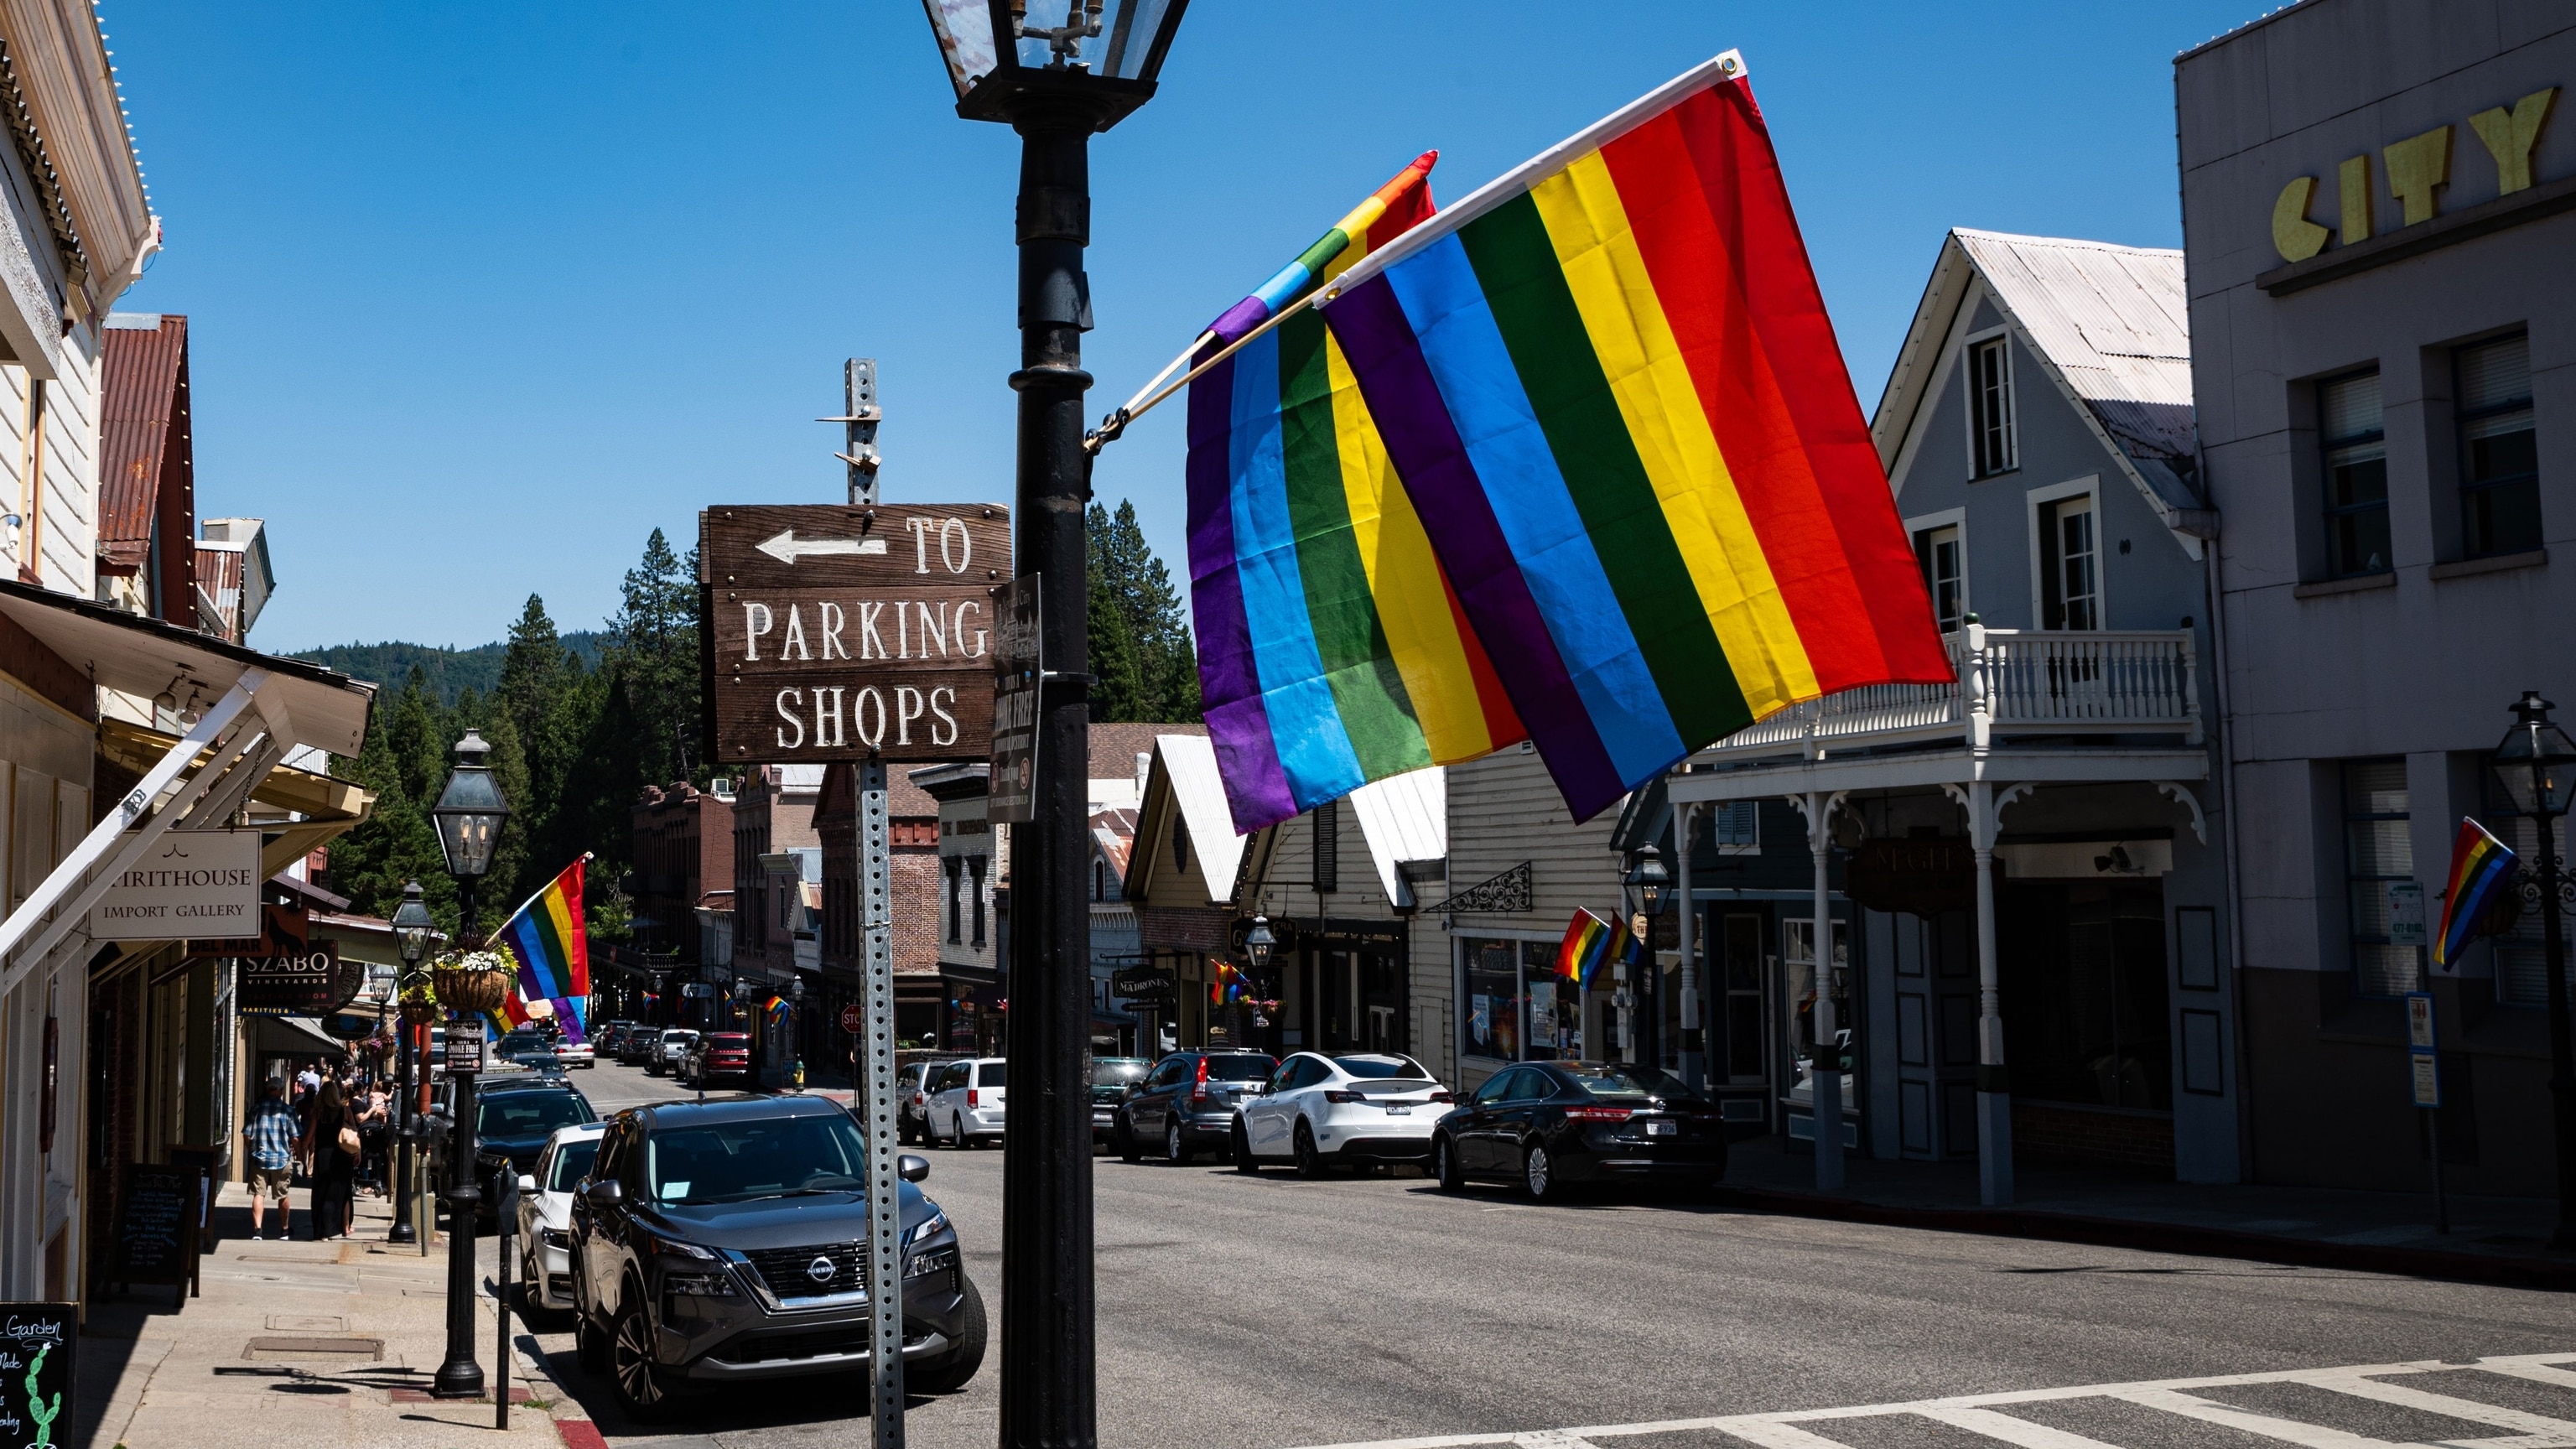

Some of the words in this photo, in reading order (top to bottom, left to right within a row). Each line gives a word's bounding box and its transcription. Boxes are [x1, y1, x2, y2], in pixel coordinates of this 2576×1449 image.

[2272, 86, 2562, 263] CITY
[906, 516, 972, 574] TO
[1019, 589, 1031, 606] City
[742, 600, 989, 662] PARKING
[776, 685, 959, 748] SHOPS
[1013, 690, 1034, 728] FREE
[111, 869, 251, 888] IRITHOUSE
[104, 906, 168, 918] IMPORT
[176, 904, 245, 917] GALLERY
[1273, 922, 1293, 937] ERA
[189, 939, 220, 953] DEL
[223, 938, 262, 953] MAR
[844, 1013, 860, 1025] STO
[448, 1044, 465, 1054] SMOKE
[466, 1044, 480, 1054] FREE
[807, 1266, 836, 1275] NISSAN
[7, 1315, 63, 1341] Garden
